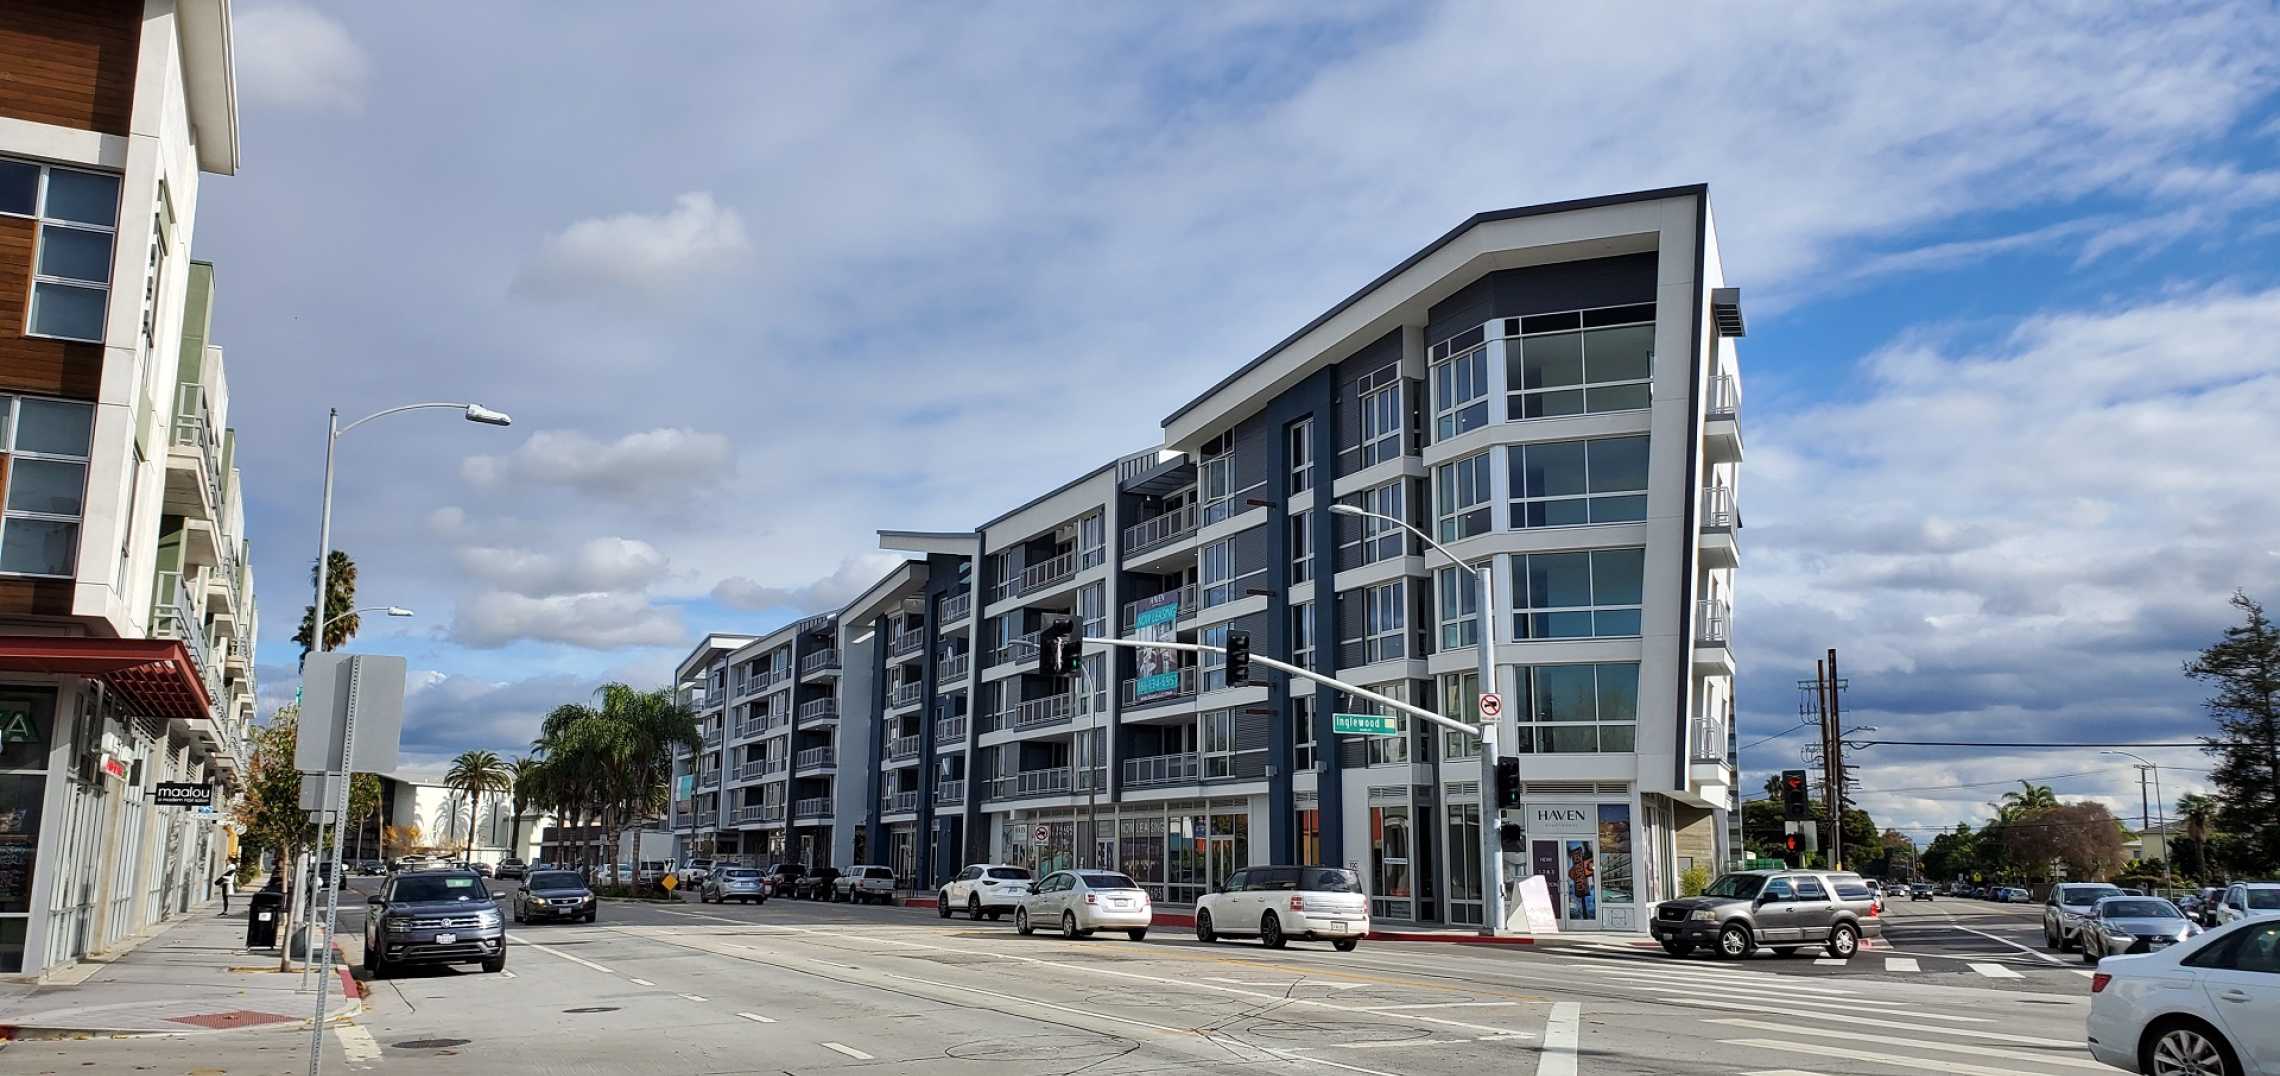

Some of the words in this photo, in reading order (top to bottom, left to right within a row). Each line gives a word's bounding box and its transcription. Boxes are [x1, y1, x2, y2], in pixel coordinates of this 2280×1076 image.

[1336, 716, 1380, 729] Inglewood
[157, 786, 210, 798] maalou
[1538, 809, 1585, 821] HAVEN
